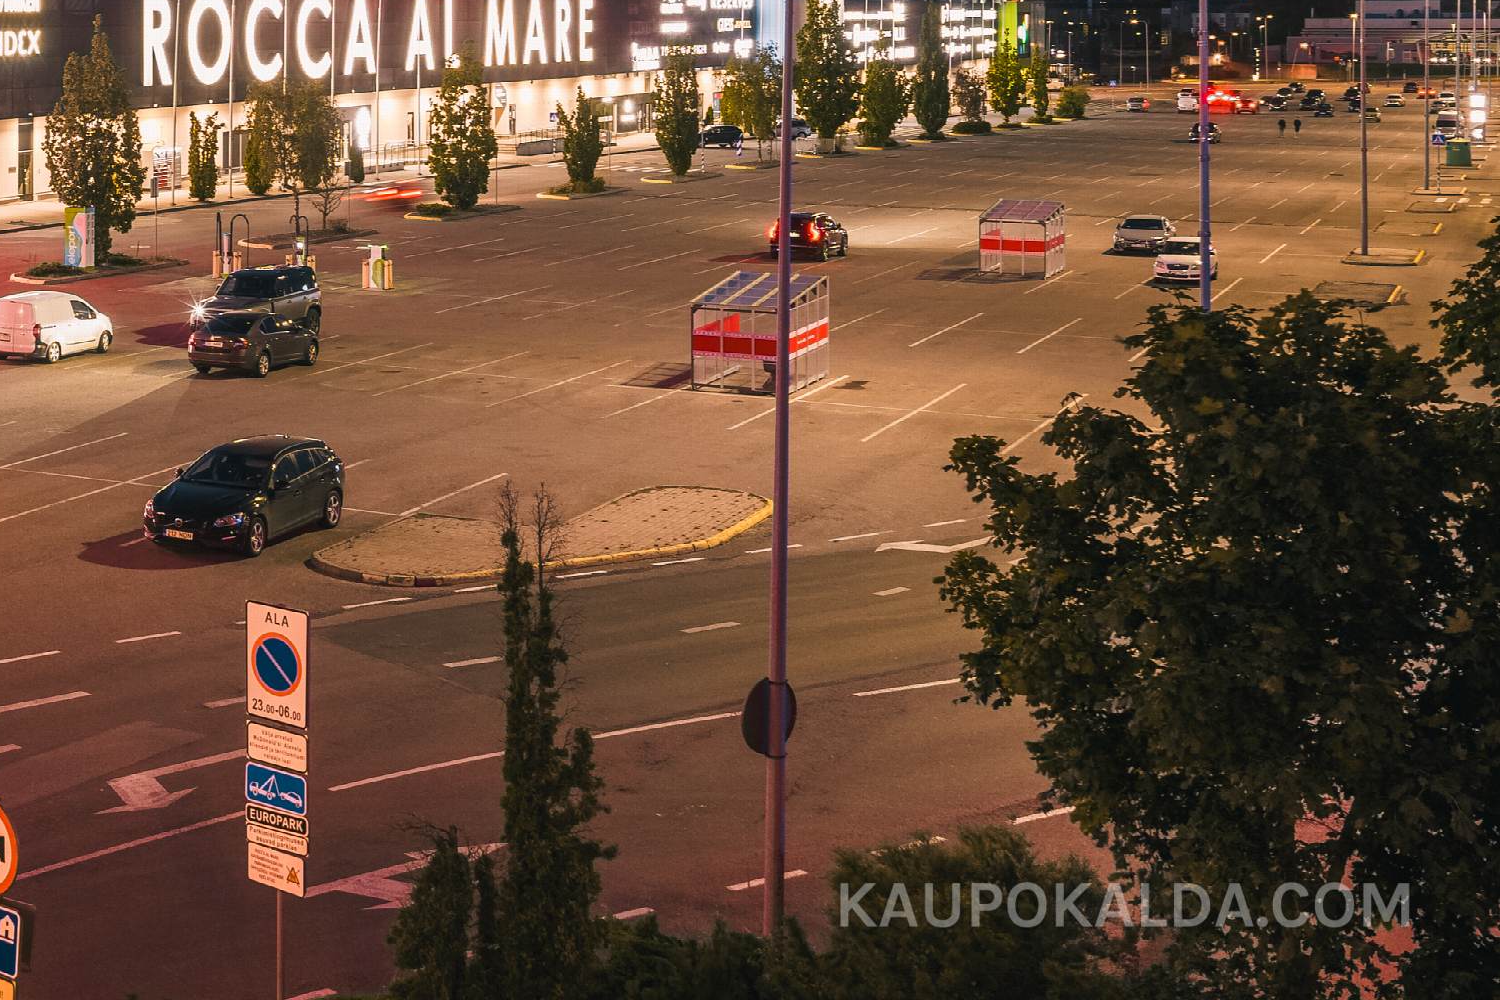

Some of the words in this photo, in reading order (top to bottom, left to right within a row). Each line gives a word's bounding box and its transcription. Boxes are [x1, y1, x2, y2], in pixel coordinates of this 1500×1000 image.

[265, 612, 289, 628] ALA
[252, 698, 301, 721] 23.00-06.00
[249, 808, 304, 833] EUROPARK
